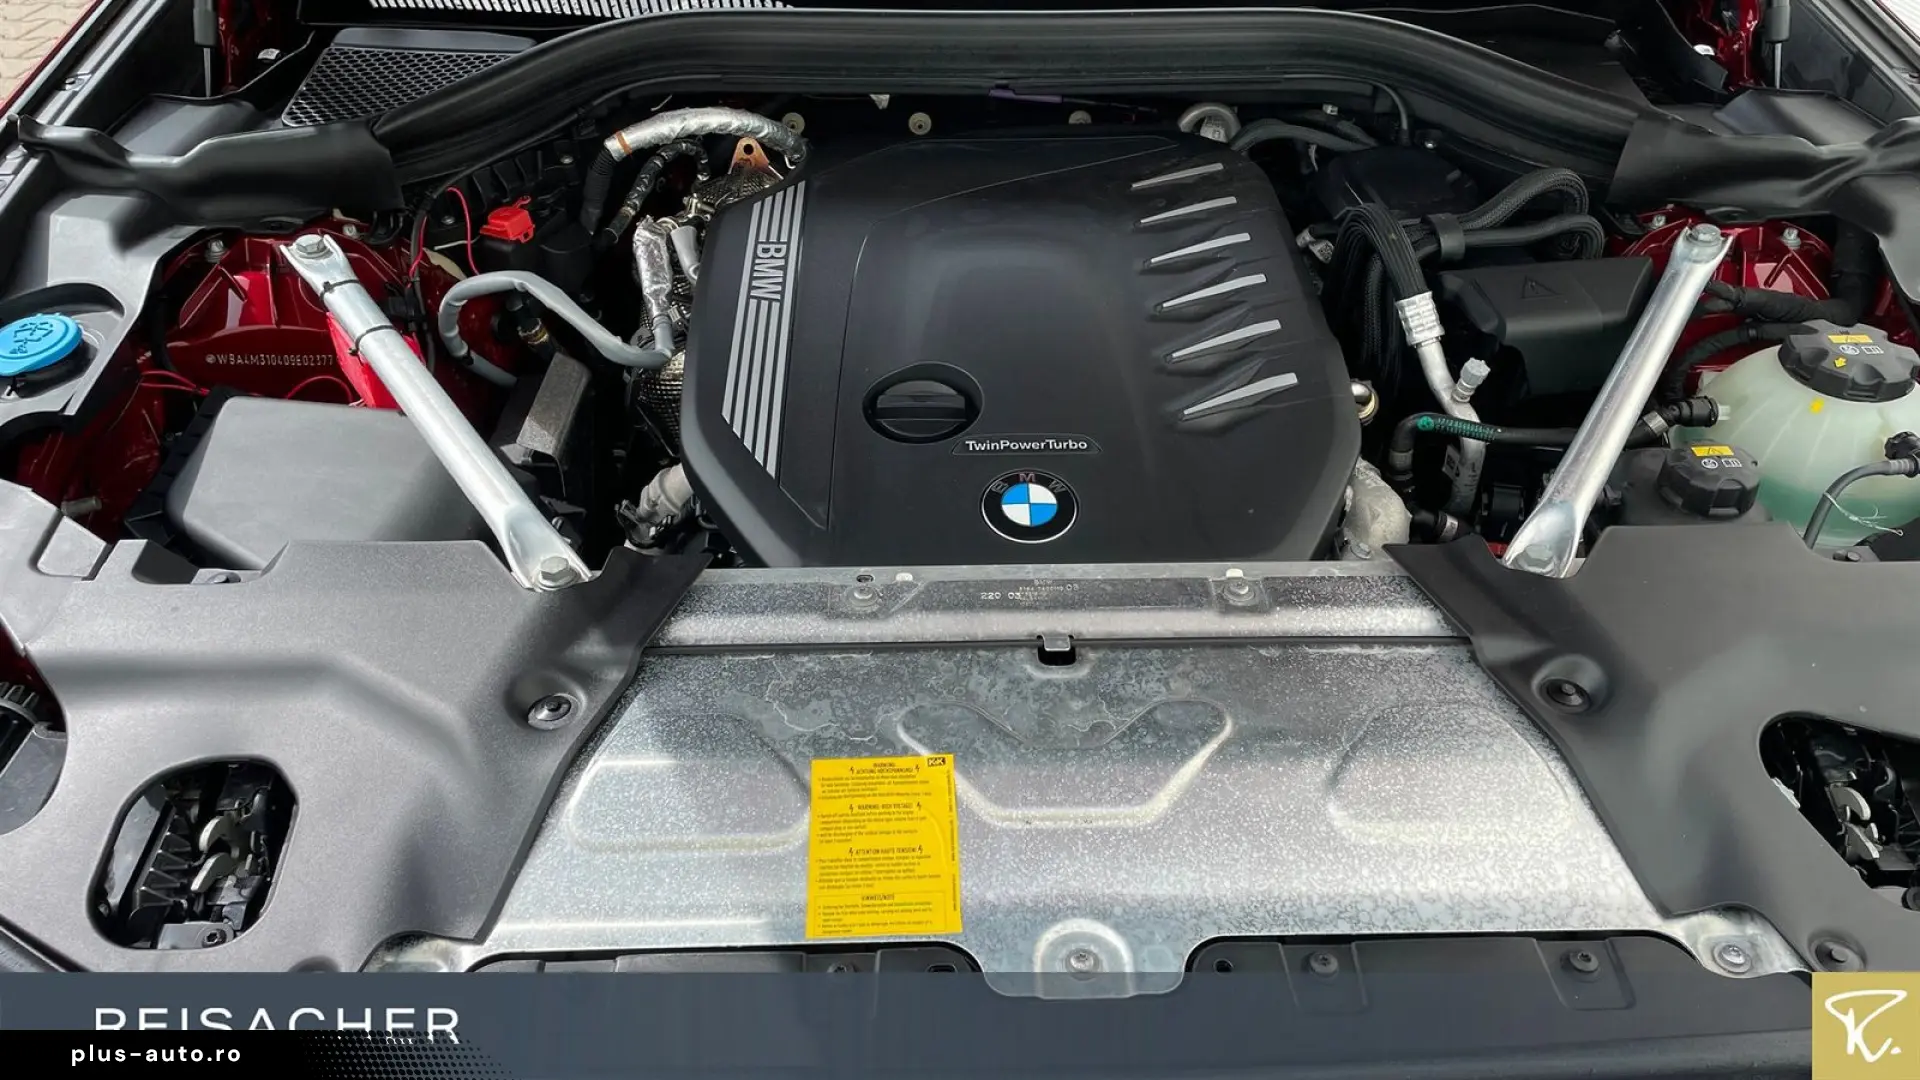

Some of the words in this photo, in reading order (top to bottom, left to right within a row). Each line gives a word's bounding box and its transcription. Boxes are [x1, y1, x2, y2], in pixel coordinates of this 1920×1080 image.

[750, 244, 787, 299] BMW
[965, 439, 1088, 451] TwinPowerTurbo
[981, 592, 1001, 600] 220
